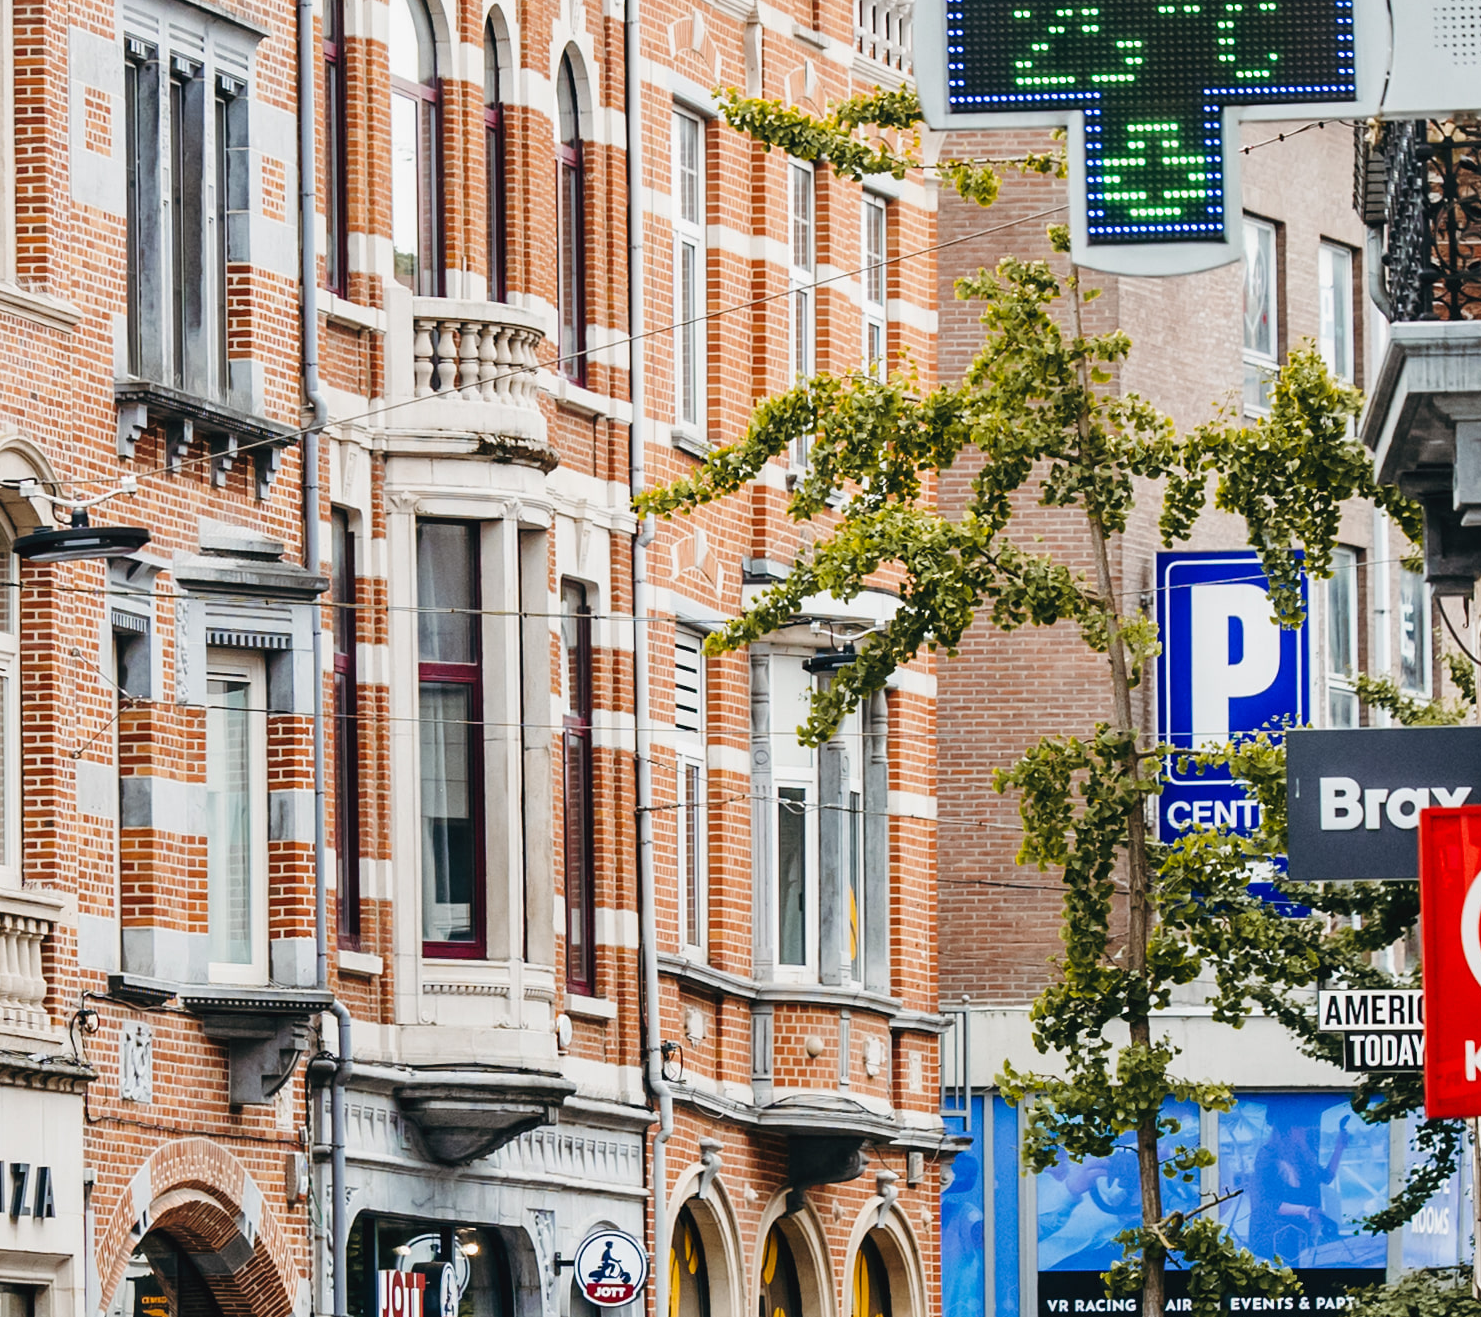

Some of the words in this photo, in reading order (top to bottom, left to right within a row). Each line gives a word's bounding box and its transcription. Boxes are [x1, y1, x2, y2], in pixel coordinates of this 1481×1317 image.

[1191, 583, 1281, 749] P
[1349, 1034, 1426, 1068] TODAY
[593, 1286, 626, 1298] JOTT
[1047, 1299, 1069, 1312] VR
[1074, 1299, 1137, 1312] RACING
[1230, 1296, 1294, 1311] EVENTS
[1299, 1297, 1310, 1310] &
